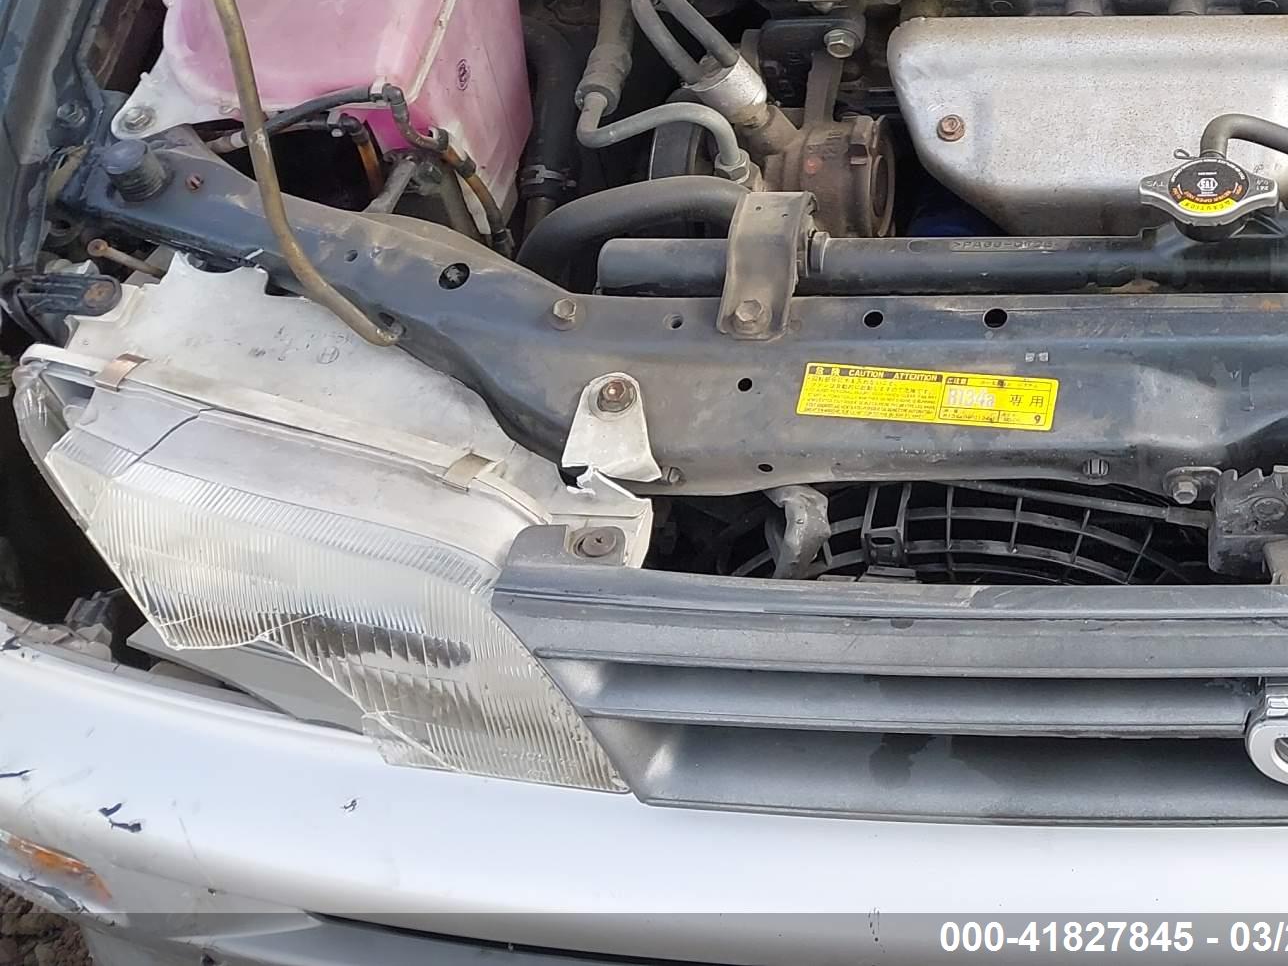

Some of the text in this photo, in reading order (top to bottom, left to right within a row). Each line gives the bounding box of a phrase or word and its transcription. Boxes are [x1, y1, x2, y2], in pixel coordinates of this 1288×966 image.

[848, 369, 938, 382] CAUTION ATTENTION
[1033, 414, 1042, 424] 9
